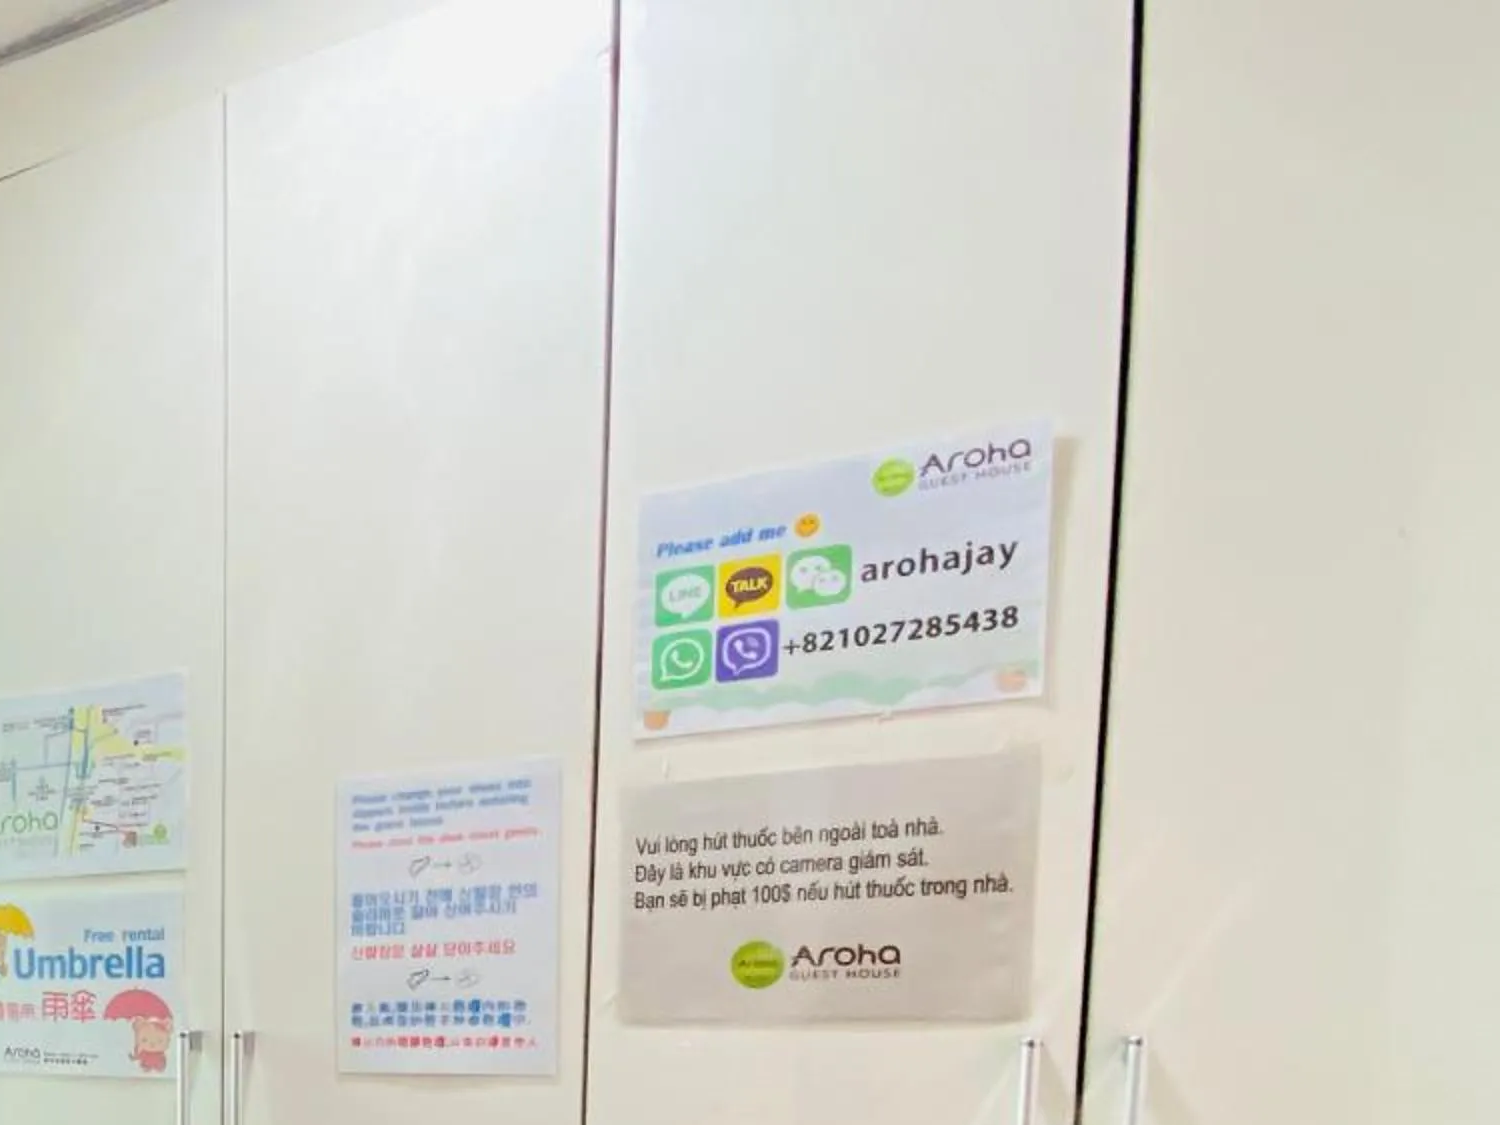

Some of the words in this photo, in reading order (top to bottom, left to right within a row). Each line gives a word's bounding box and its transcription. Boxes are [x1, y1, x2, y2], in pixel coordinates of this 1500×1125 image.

[921, 438, 1032, 476] Aroha
[656, 537, 714, 558] Please
[719, 527, 754, 547] add
[758, 525, 788, 541] me
[860, 539, 1019, 583] arohajay
[730, 577, 769, 593] TALK
[783, 605, 1019, 655] +821027285438
[636, 837, 661, 856] Vui
[665, 835, 698, 857] lòng
[703, 832, 728, 851] hút
[732, 826, 777, 849] thuốc
[782, 826, 813, 846] bên
[819, 818, 867, 847] ngoài
[634, 863, 666, 887] Đây
[669, 861, 684, 881] là
[689, 861, 717, 880] khu
[721, 861, 751, 882] vực
[755, 856, 775, 876] có
[779, 856, 843, 875] camera
[849, 850, 891, 874] giám
[897, 847, 929, 868] sát.
[634, 891, 665, 912] Bạn
[669, 889, 688, 908] sẽ
[693, 888, 706, 911] bị
[711, 887, 746, 910] phạt
[753, 883, 791, 903] 100$
[797, 880, 828, 902] nếu
[834, 881, 861, 900] hút
[866, 876, 915, 898] thuốc
[920, 878, 967, 899] trong
[84, 928, 114, 943] Free
[122, 927, 165, 942] rental
[14, 946, 165, 980] Umbrella
[791, 944, 901, 968] Aroha
[789, 968, 838, 981] GUEST
[846, 968, 900, 979] HOUSE
